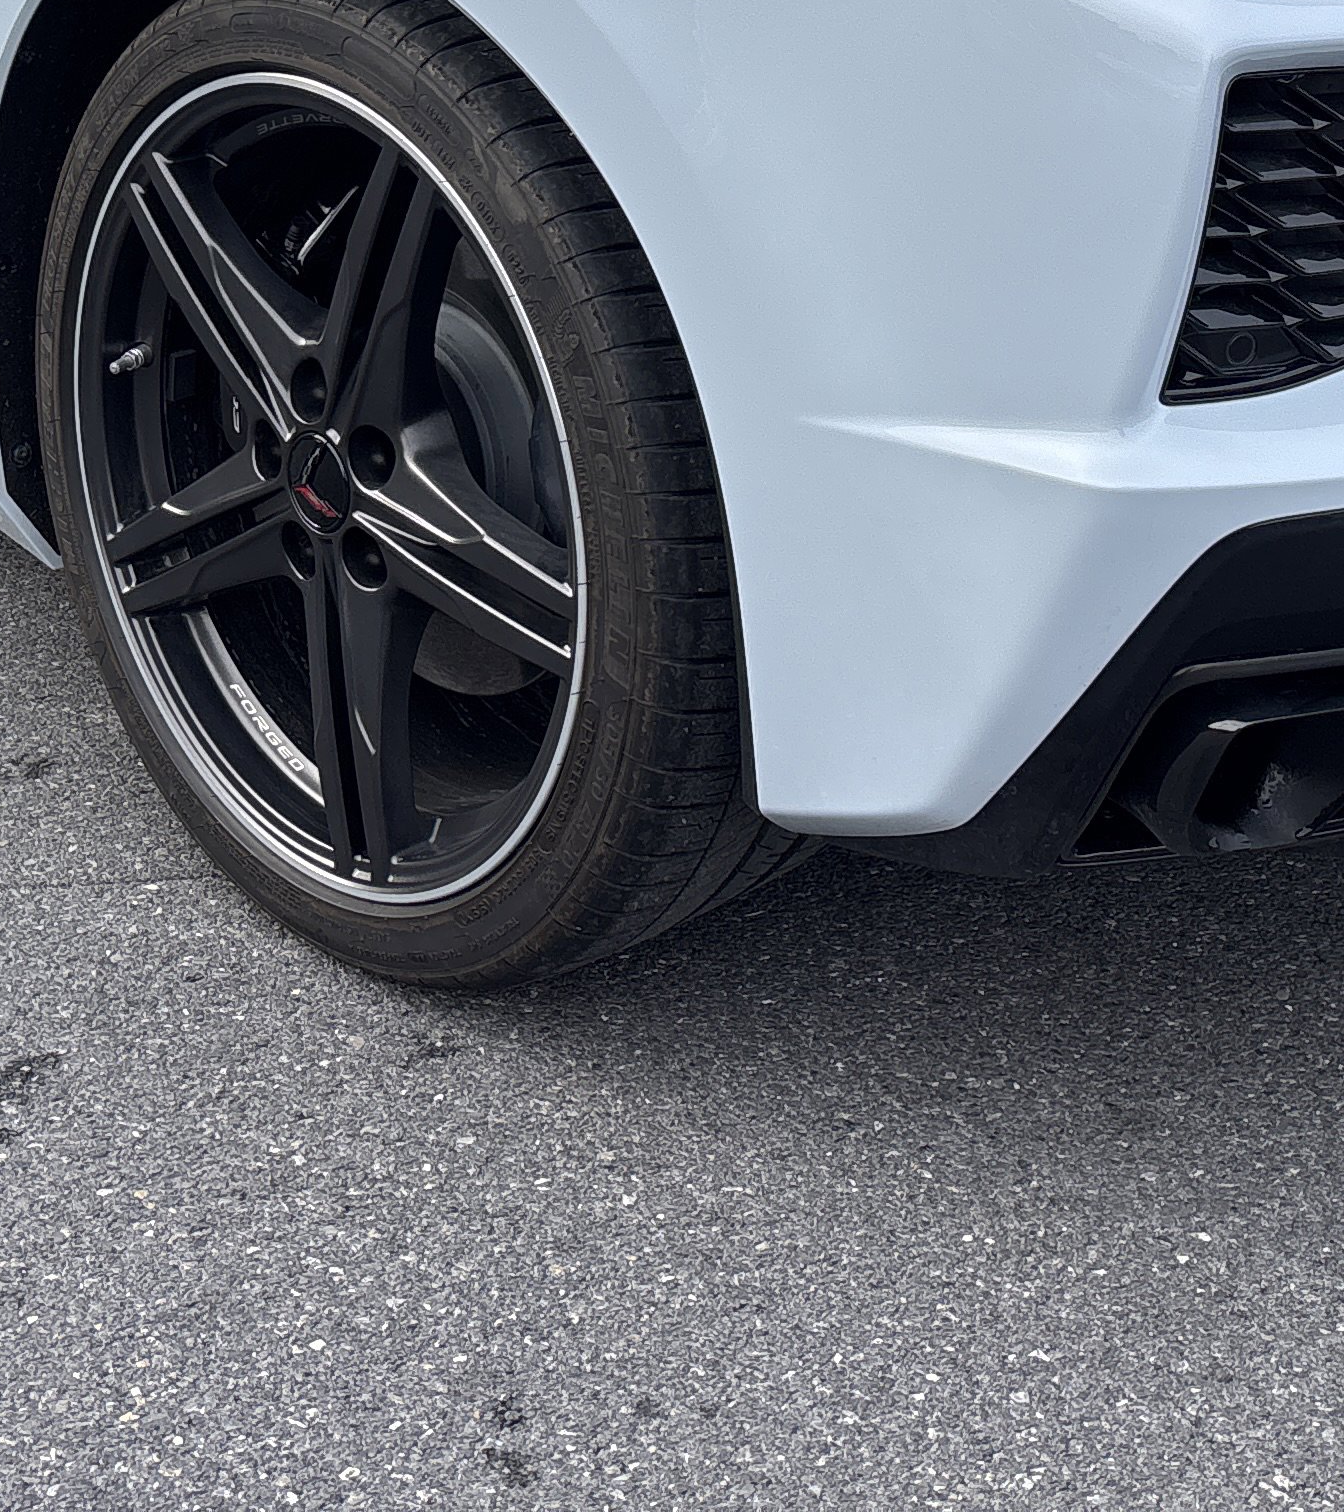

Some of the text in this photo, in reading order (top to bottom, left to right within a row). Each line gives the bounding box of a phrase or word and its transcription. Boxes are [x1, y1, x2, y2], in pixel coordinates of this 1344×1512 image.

[257, 113, 346, 136] RVETTE
[572, 375, 630, 666] MICHELIN
[230, 684, 305, 772] FORGED
